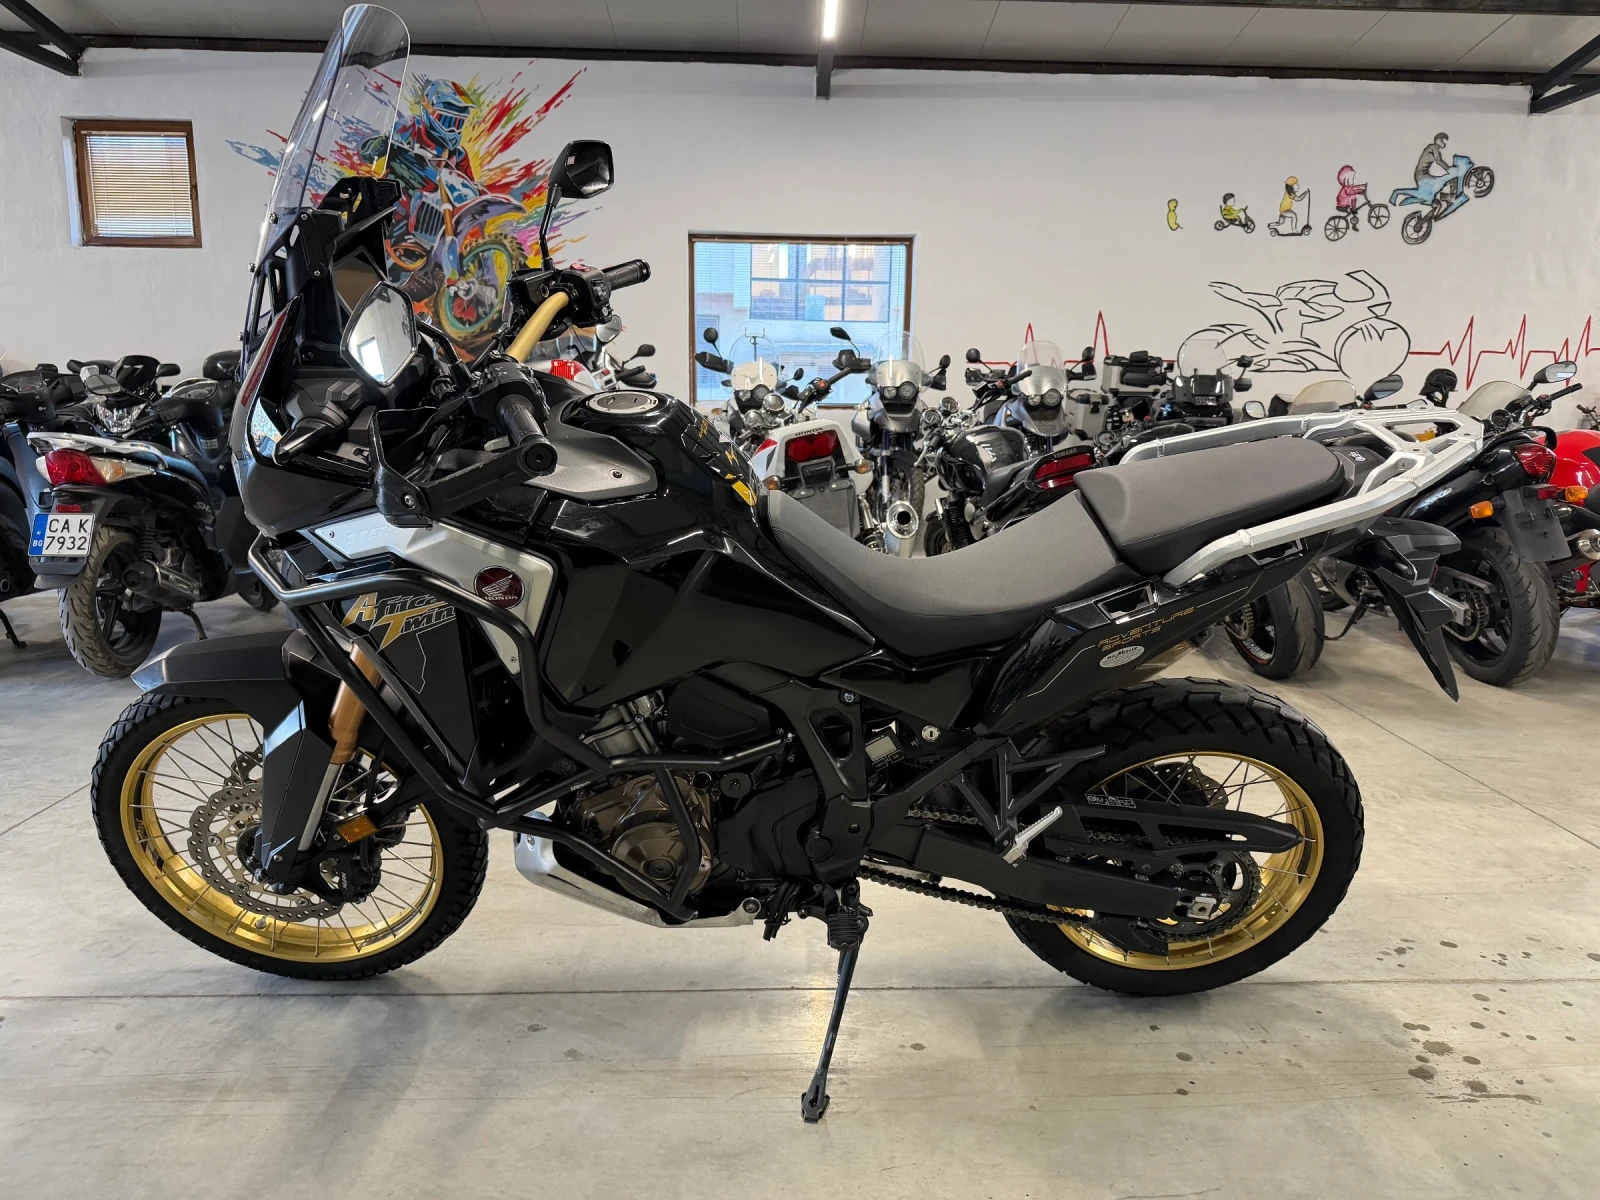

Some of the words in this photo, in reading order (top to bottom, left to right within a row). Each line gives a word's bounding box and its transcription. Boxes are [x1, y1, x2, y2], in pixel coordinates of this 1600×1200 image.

[795, 427, 823, 436] HONDA
[1053, 447, 1078, 459] YAMAHA
[48, 518, 70, 533] CA
[78, 518, 89, 533] K
[32, 539, 43, 547] BG
[45, 536, 87, 551] 7932
[1097, 606, 1195, 648] ADVENTURE
[1102, 626, 1162, 652] SPORTS
